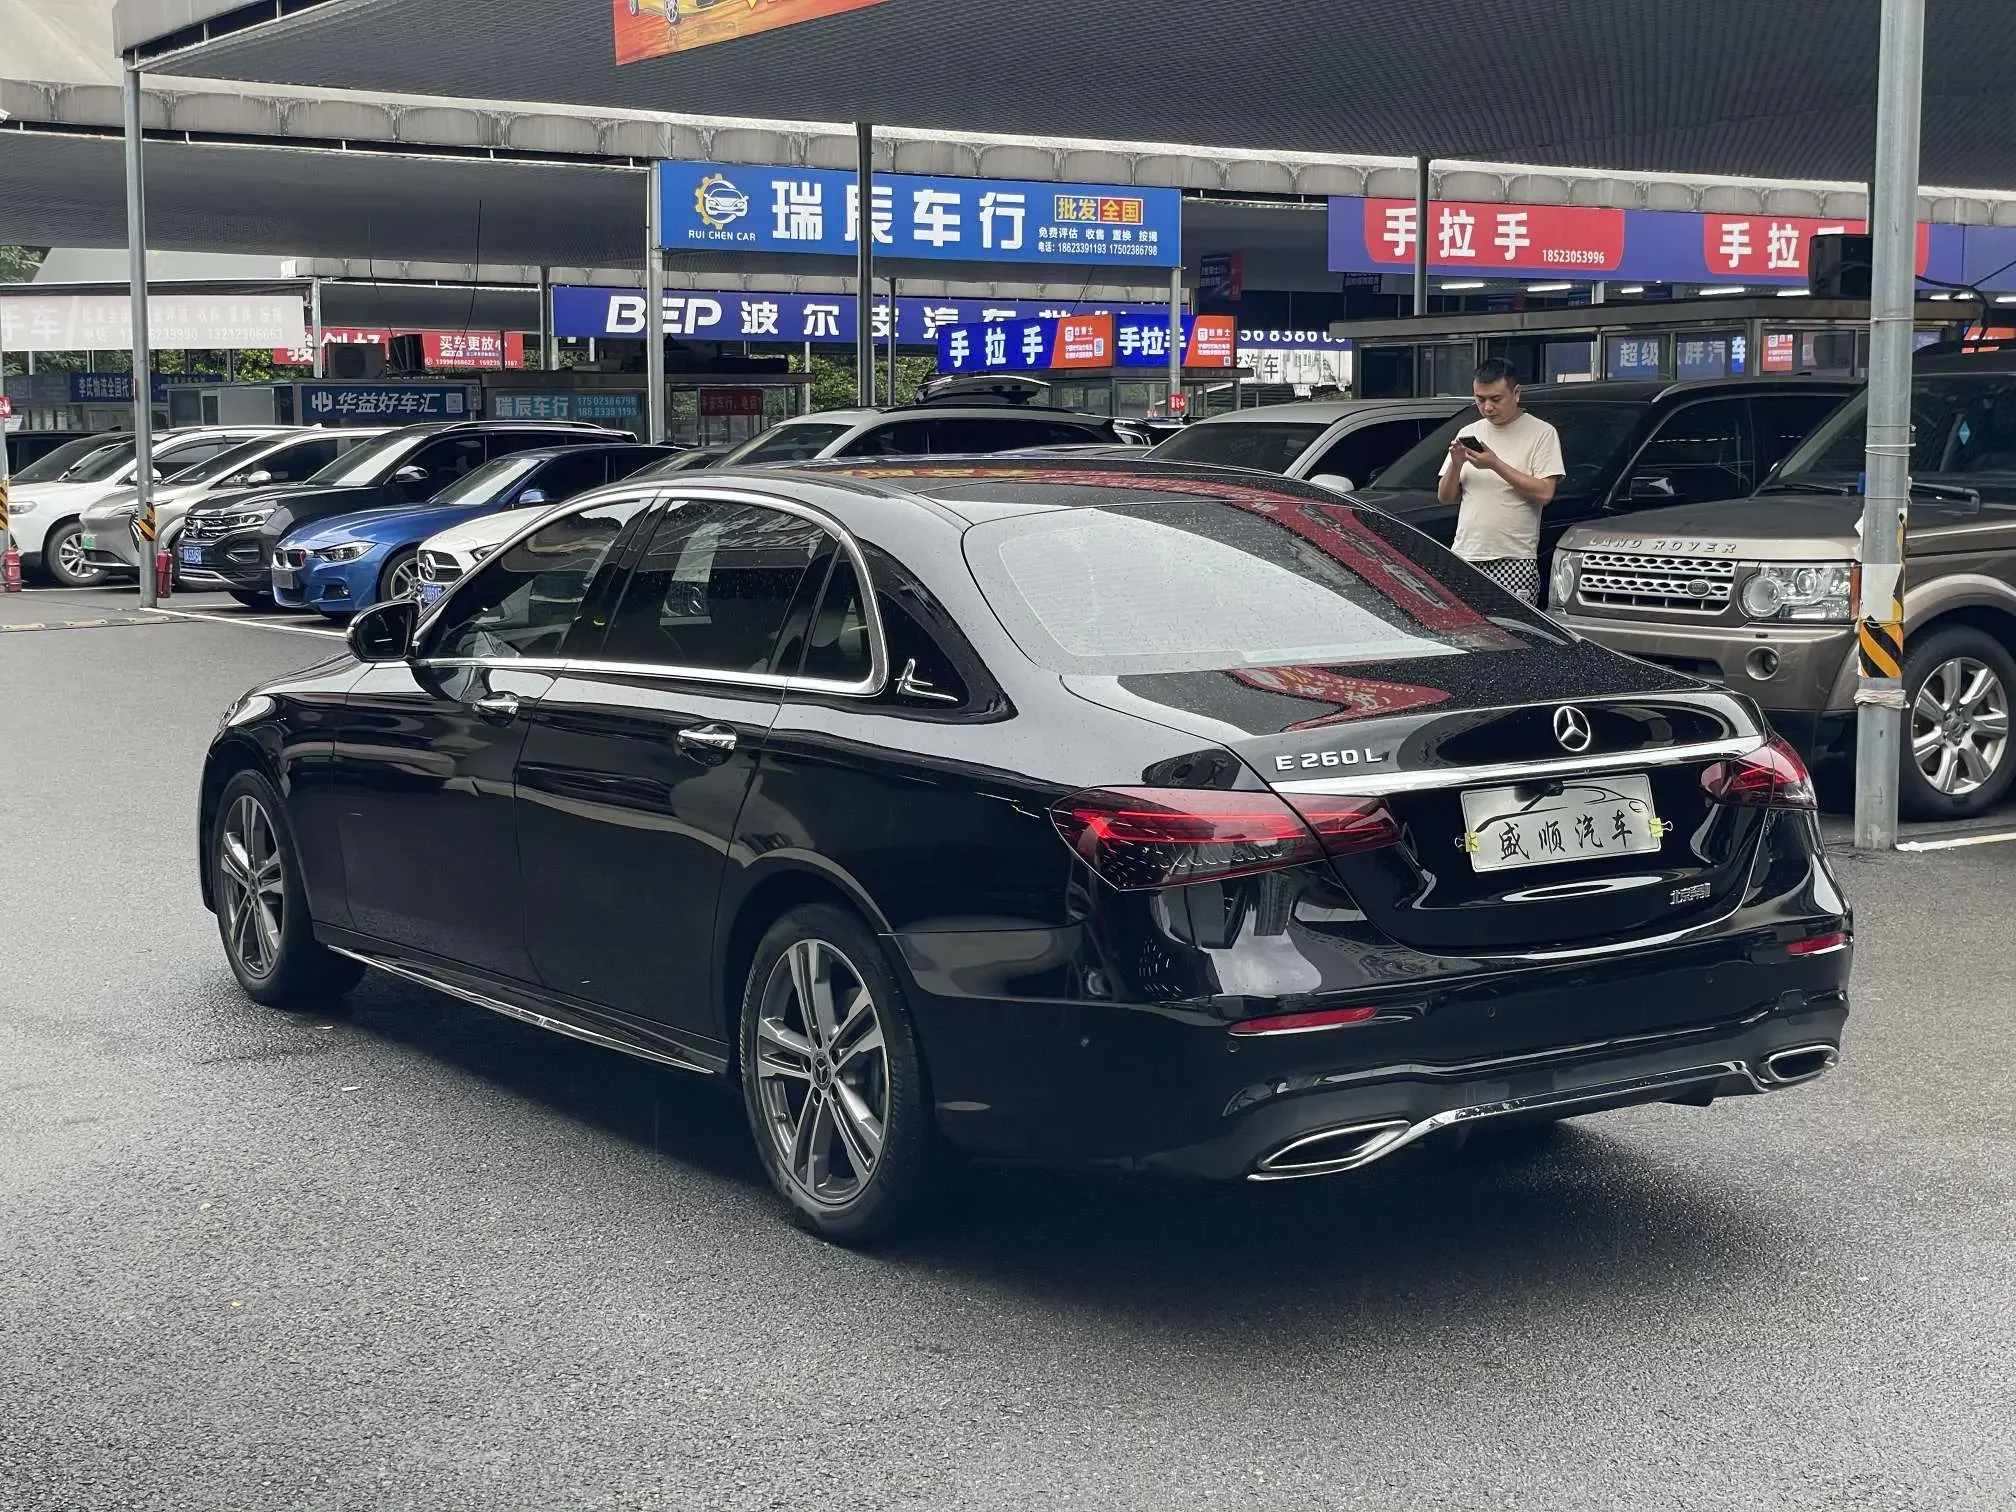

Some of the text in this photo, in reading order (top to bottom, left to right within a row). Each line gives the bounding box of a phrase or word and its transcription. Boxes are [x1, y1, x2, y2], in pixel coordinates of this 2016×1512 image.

[770, 180, 1026, 250] 瑞辰车行
[688, 229, 756, 242] RUI CHEN CAR
[1038, 226, 1079, 239] 免费评估
[1111, 229, 1132, 241] 置换
[1138, 230, 1158, 242] 按揭
[1383, 206, 1531, 261] 手拉手
[1719, 221, 1846, 270] 手拉
[1058, 242, 1107, 254] 18623391193
[1109, 244, 1158, 256] 17502386798
[1541, 248, 1606, 265] 18523053996
[605, 295, 723, 334] BEP
[949, 325, 1044, 368] 手拉手
[335, 391, 440, 415] 华益好车汇
[495, 395, 569, 417] 瑞辰车行
[1588, 537, 1737, 555] LAND ROVER
[1275, 746, 1386, 771] E 260 L
[1498, 809, 1634, 861] 盛顺汽车
